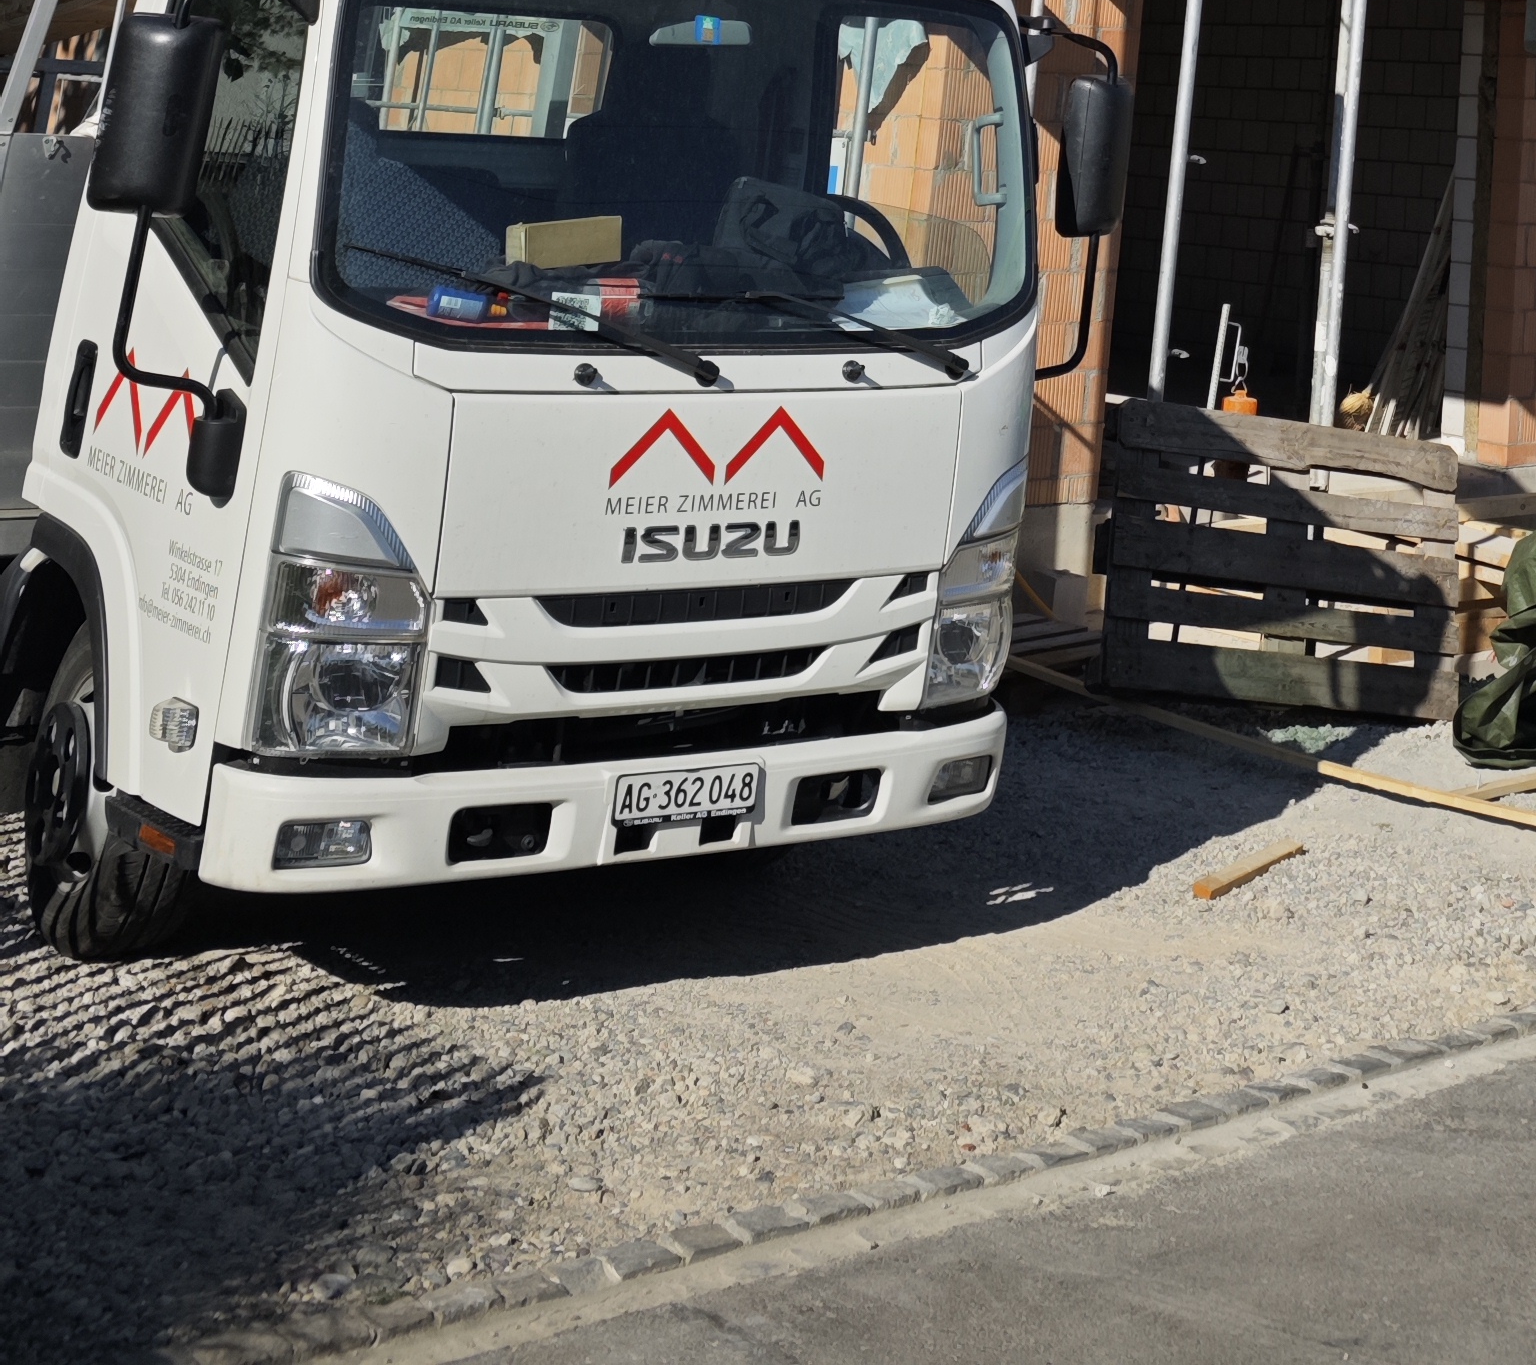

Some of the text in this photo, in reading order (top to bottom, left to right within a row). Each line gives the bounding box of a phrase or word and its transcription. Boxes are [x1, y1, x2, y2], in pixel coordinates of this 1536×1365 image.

[87, 445, 193, 516] MEIER ZIMMEREI AG
[605, 490, 822, 515] MEIER ZIMMEREI AG
[169, 539, 223, 577] Winkelstrasse 17
[621, 520, 800, 564] ISUZU
[169, 563, 218, 600] 5304 Endingen
[172, 587, 184, 607] 056
[184, 594, 198, 614] 242
[198, 599, 206, 617] 11
[207, 603, 216, 621] 10
[619, 782, 652, 815] AG
[634, 808, 747, 825] SUBARU Keller AG Endingen
